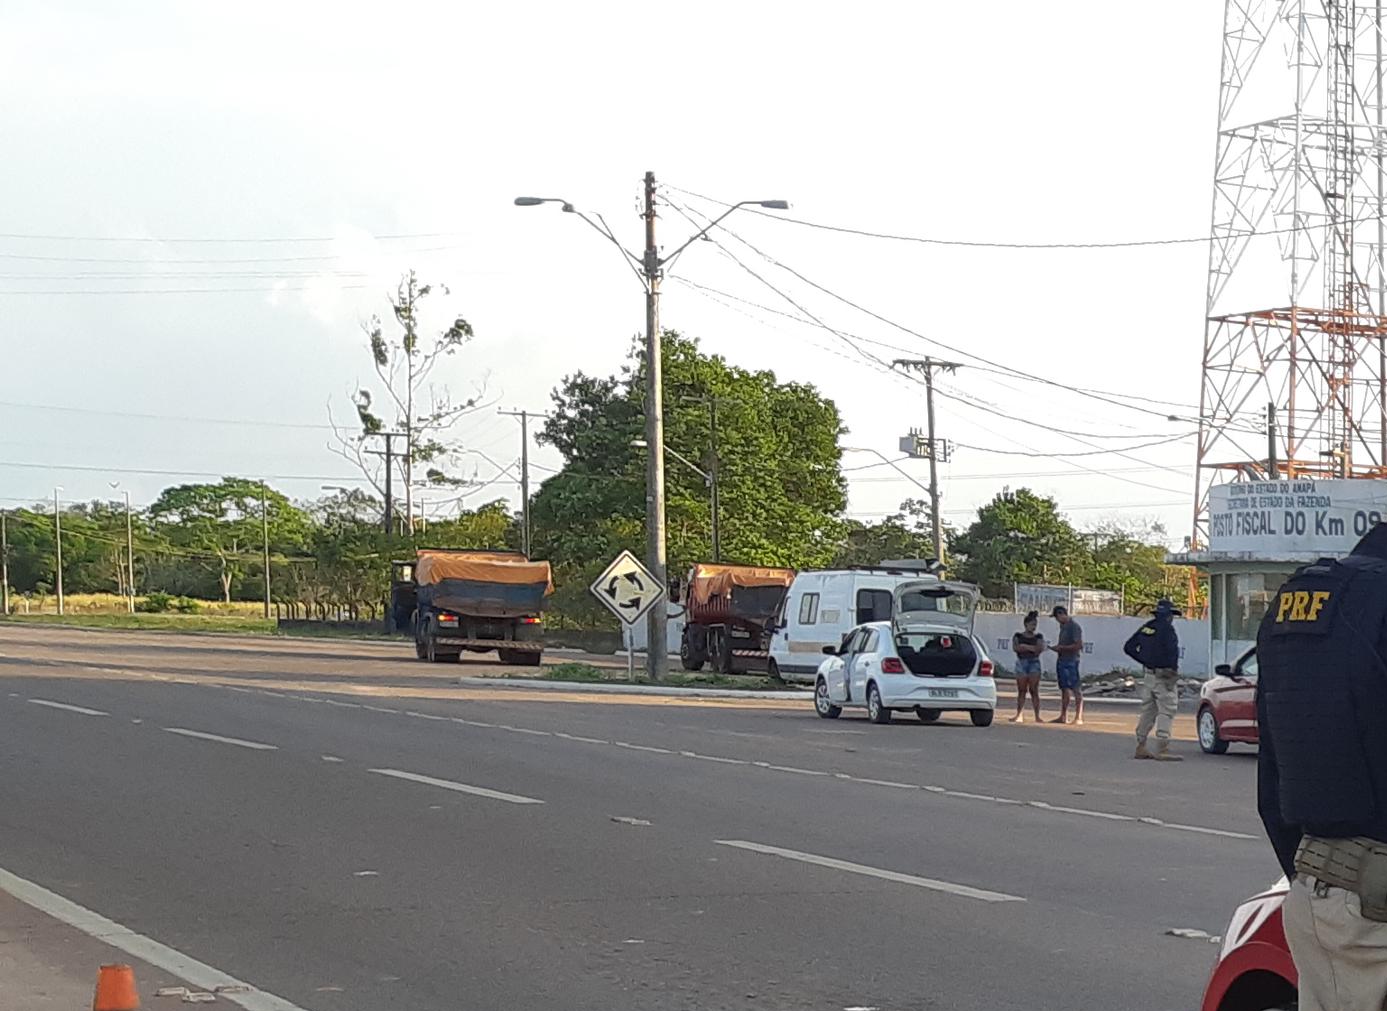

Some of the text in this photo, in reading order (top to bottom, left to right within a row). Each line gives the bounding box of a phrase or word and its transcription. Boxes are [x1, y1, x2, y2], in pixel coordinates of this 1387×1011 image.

[1279, 483, 1290, 494] DO
[1285, 496, 1295, 508] DA
[1297, 495, 1331, 508] FAZENDA
[1236, 510, 1277, 536] FISCAL
[1284, 510, 1306, 536] DO
[1315, 510, 1345, 536] Km
[1276, 591, 1331, 623] PRF
